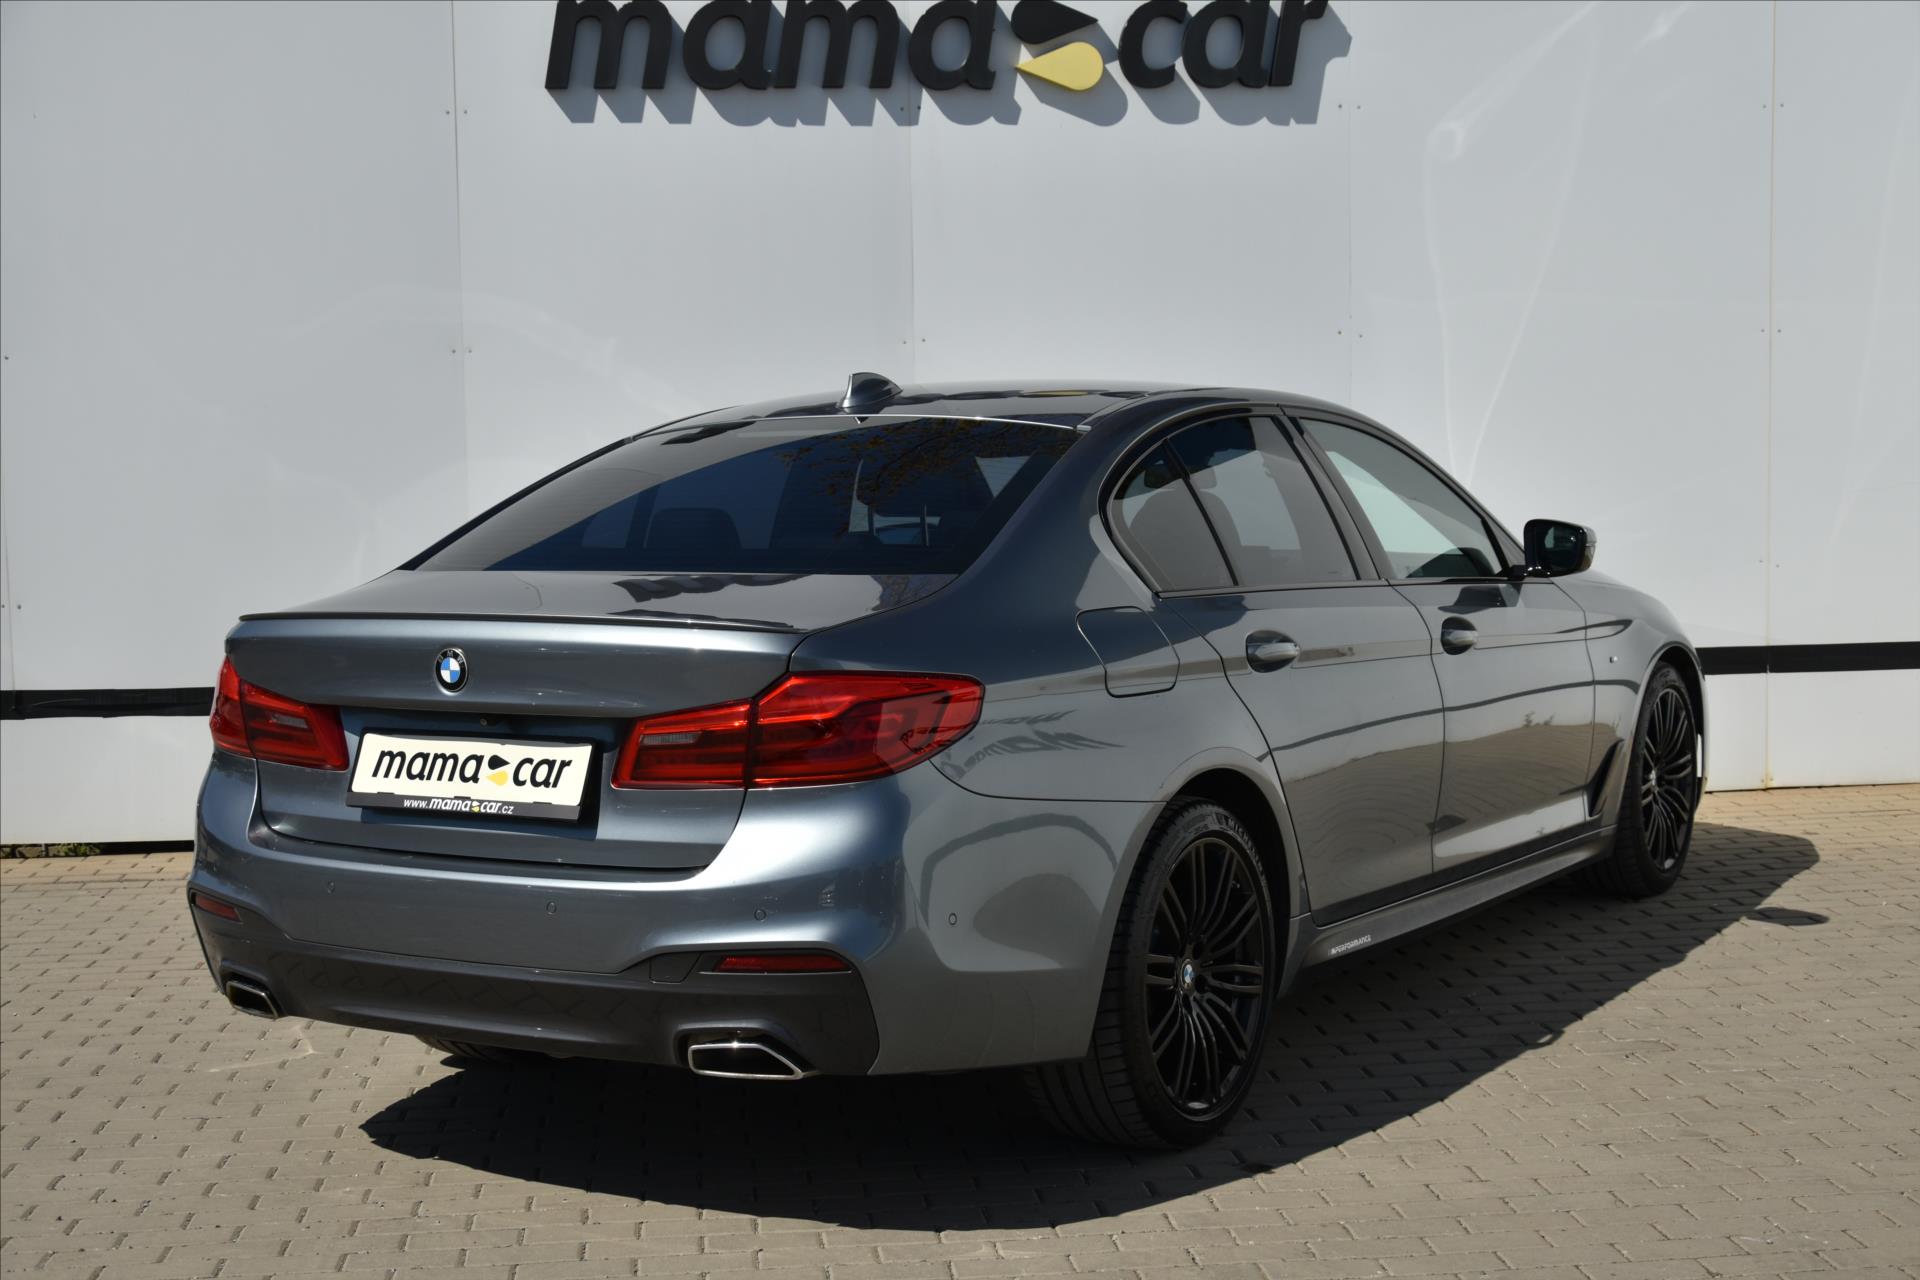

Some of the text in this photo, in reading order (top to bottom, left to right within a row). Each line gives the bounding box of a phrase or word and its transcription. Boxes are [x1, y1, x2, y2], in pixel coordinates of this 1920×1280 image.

[544, 0, 1328, 91] mama car
[371, 749, 573, 789] mama car
